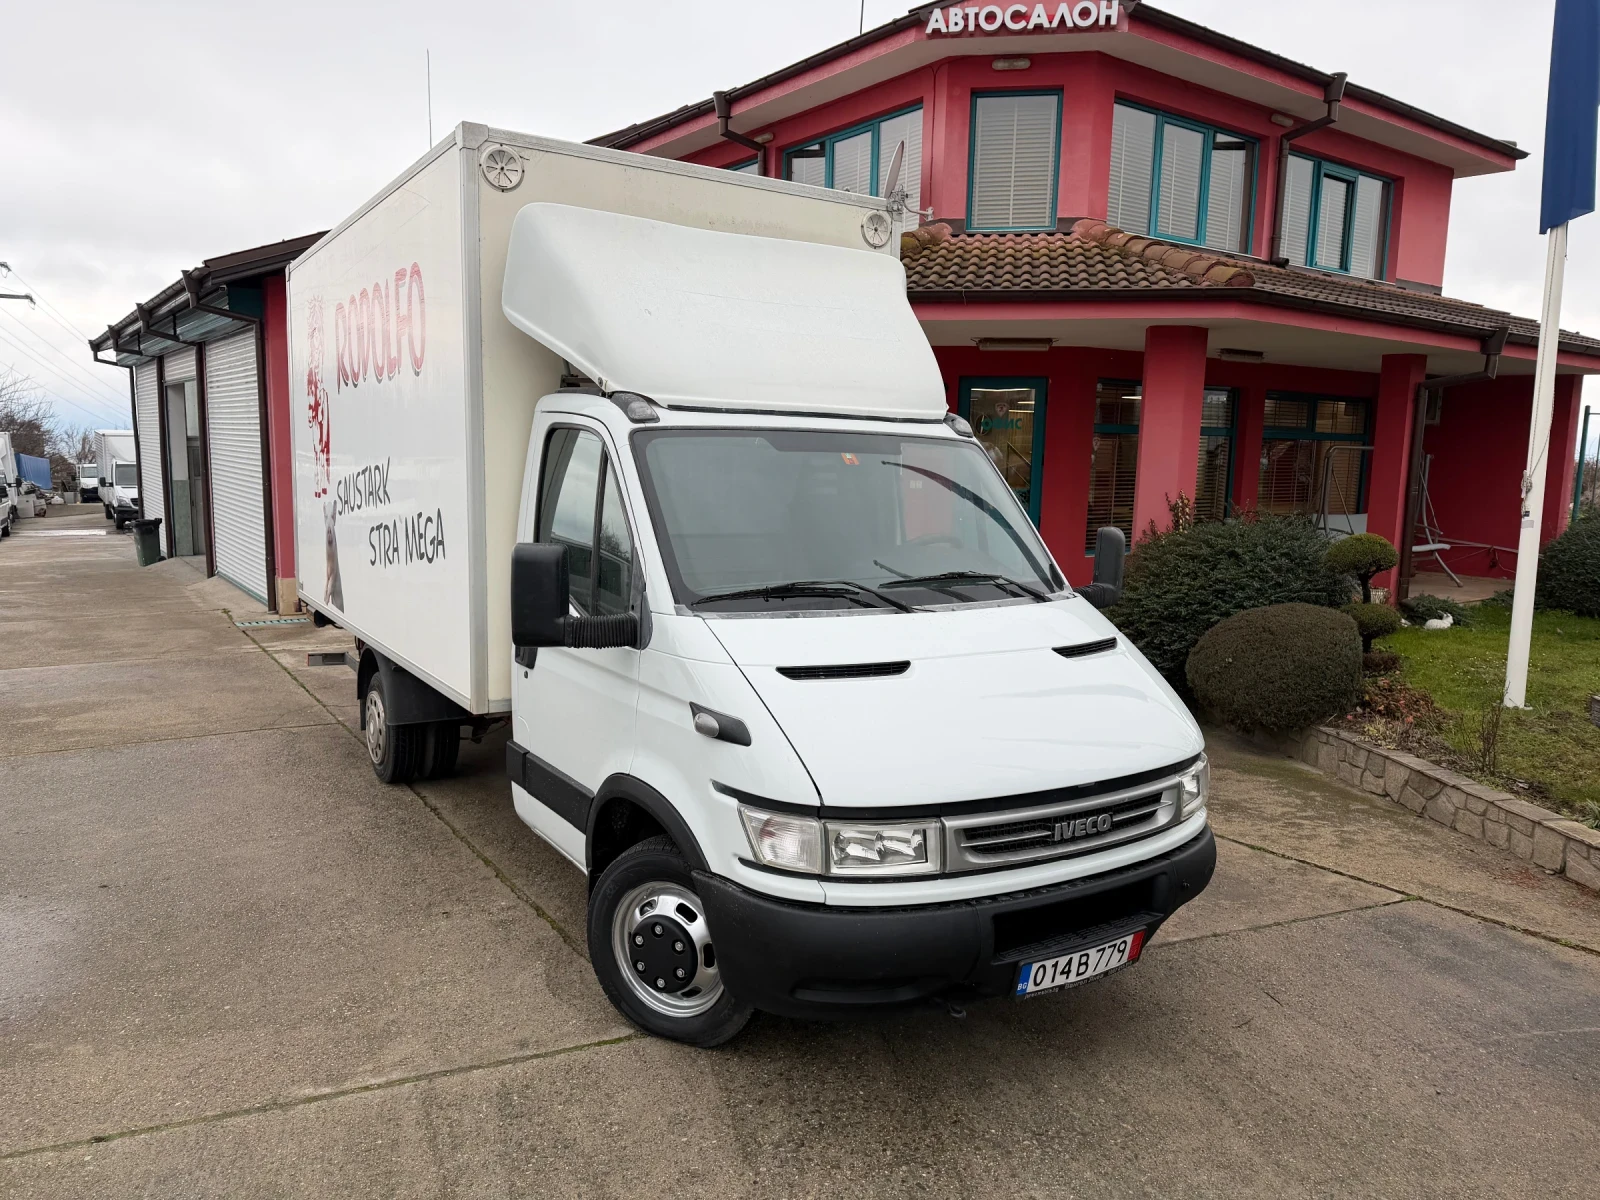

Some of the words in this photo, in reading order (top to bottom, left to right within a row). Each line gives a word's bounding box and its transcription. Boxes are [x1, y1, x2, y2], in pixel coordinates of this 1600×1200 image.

[925, 0, 1119, 34] АВТОСАЛОН
[335, 262, 426, 395] RODOLFO
[337, 456, 391, 516] SAUSTARK
[369, 519, 400, 569] STRA
[405, 507, 446, 566] MEGA
[1054, 814, 1112, 841] IVECO
[1017, 981, 1028, 991] BG
